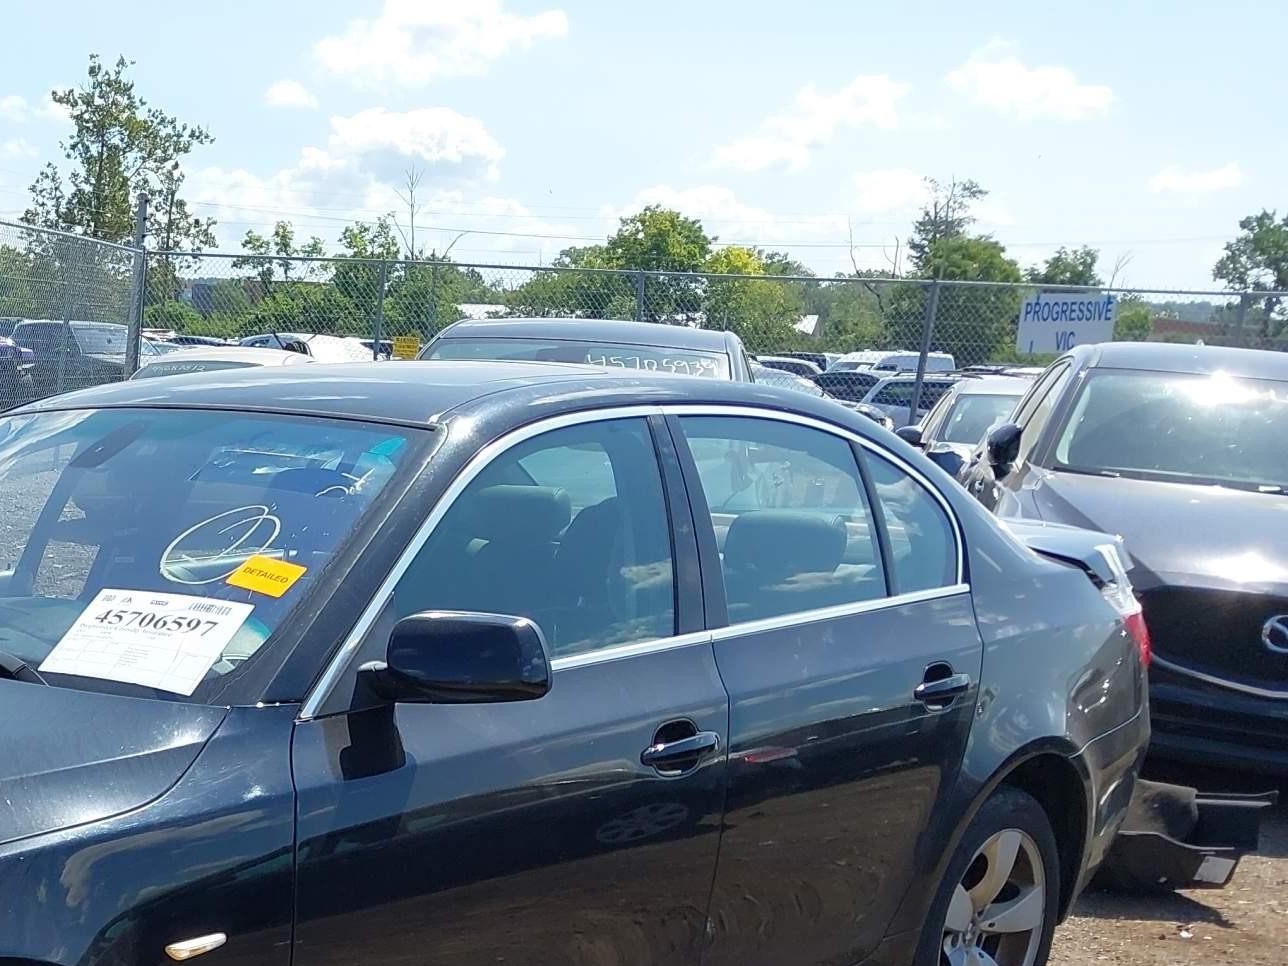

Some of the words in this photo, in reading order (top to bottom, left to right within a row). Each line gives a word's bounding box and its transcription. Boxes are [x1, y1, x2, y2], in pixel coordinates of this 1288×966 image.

[1024, 301, 1113, 322] PROGRESSIVE
[1055, 331, 1076, 351] VIC
[242, 566, 289, 584] DETAILED
[95, 609, 219, 637] 45706597
